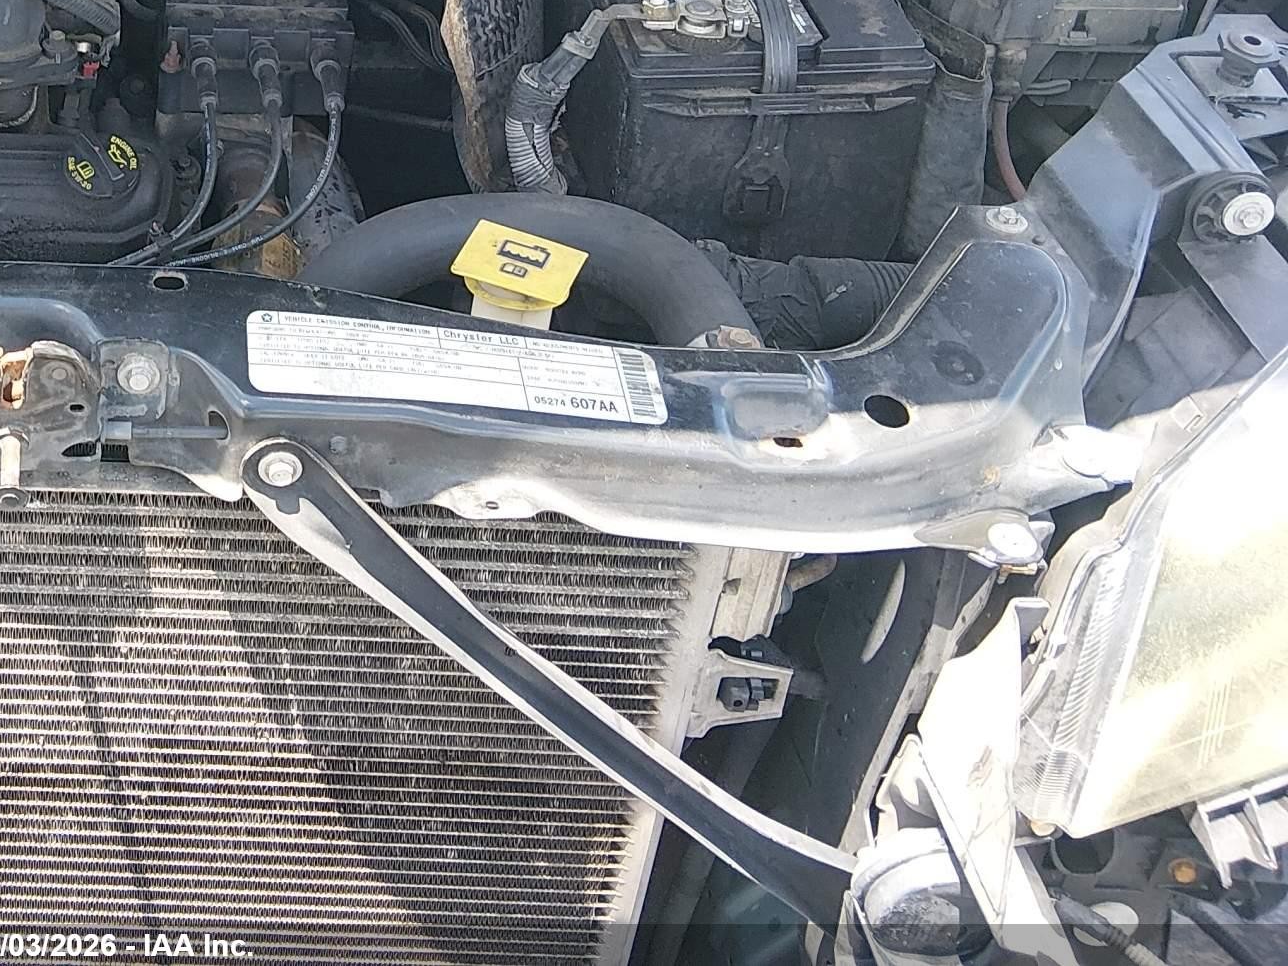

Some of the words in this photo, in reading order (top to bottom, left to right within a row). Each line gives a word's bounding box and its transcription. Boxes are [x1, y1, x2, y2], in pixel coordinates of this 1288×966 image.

[110, 135, 135, 158] ENGINE
[129, 158, 138, 170] OIL
[443, 329, 493, 345] Chrysler
[498, 334, 519, 346] LLC
[534, 395, 566, 407] 05274
[570, 397, 619, 414] 607AA
